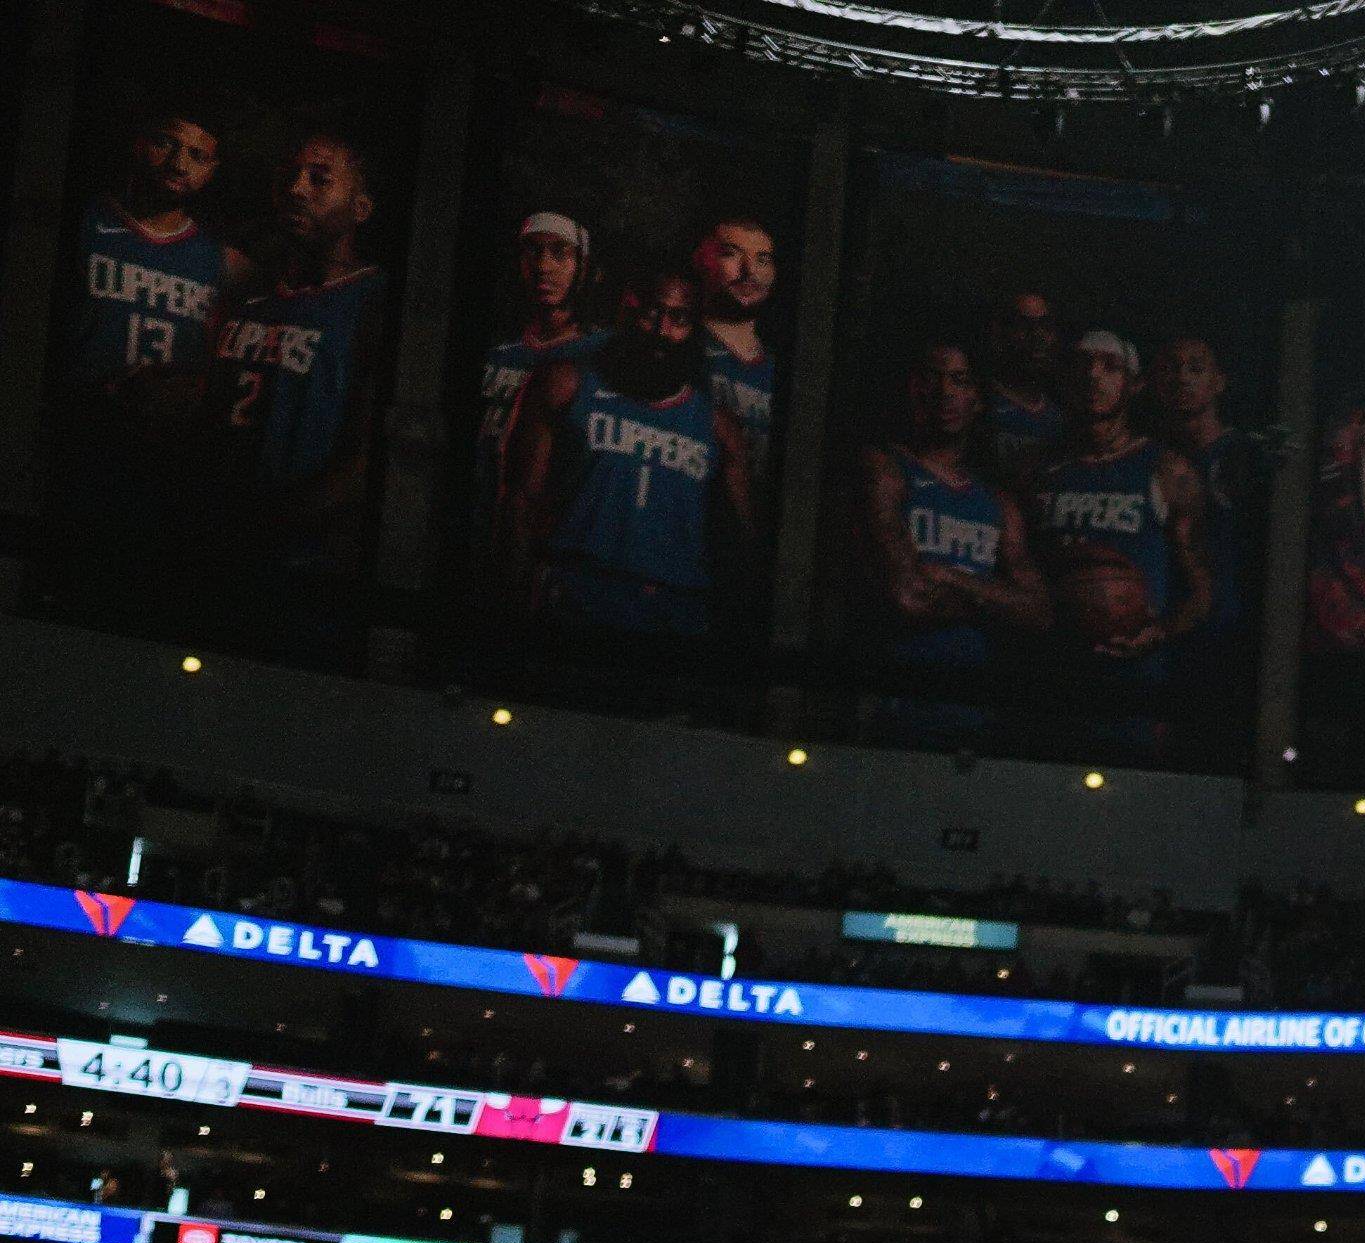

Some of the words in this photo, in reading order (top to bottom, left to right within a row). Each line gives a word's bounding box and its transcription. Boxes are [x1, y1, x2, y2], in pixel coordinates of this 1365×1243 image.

[586, 411, 710, 481] CLIPPERS
[635, 465, 651, 509] 1
[232, 920, 379, 968] DELTA
[667, 975, 803, 1016] DELTA
[1106, 1009, 1218, 1046] OFFICIAL
[1223, 1016, 1322, 1047] AIRLINE
[1324, 1017, 1360, 1048] OF
[80, 1051, 184, 1092] 4:40
